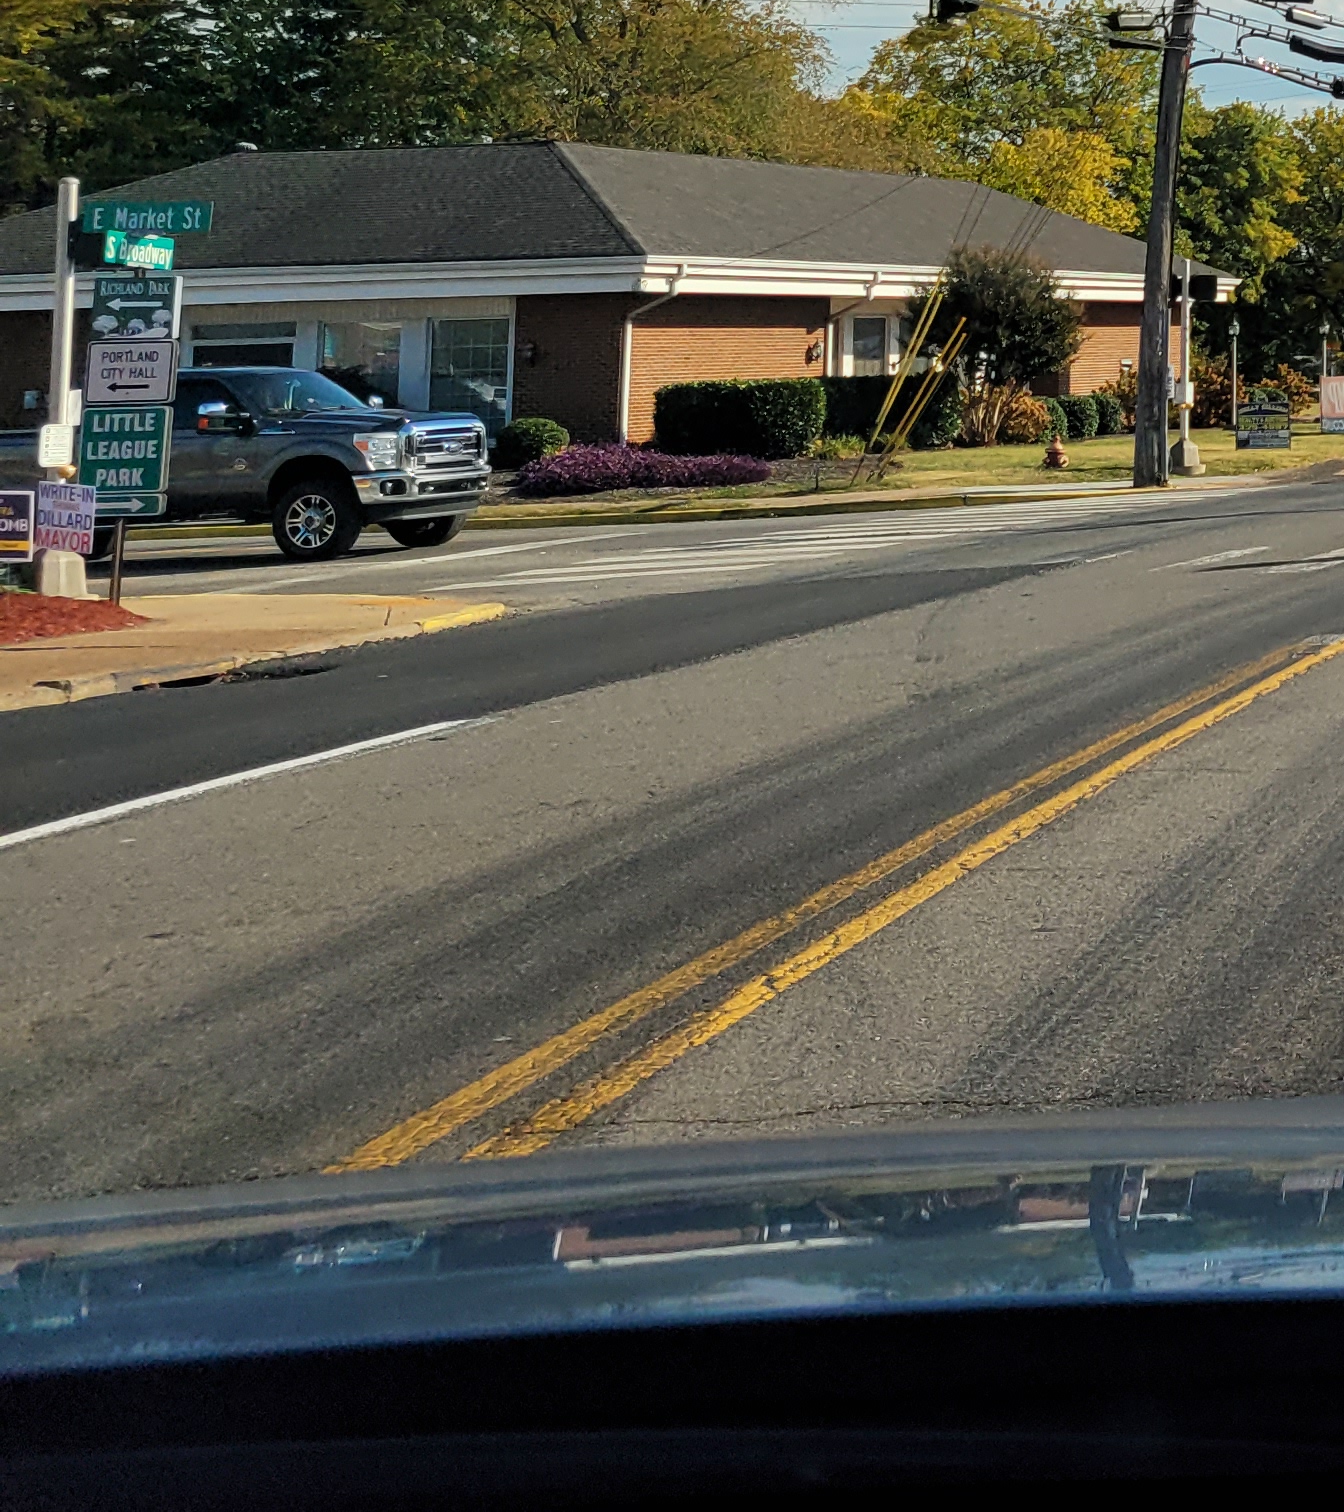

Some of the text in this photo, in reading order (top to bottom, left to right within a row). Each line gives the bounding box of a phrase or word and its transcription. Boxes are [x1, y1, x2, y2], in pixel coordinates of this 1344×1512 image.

[93, 206, 202, 230] E Market St
[106, 235, 174, 270] S Broadway
[148, 280, 171, 295] PARK
[101, 350, 160, 364] PORTLAND
[101, 367, 158, 380] CITY HALL
[91, 412, 157, 433] LITTLE
[86, 439, 158, 461] LEAGUE
[95, 467, 145, 488] PARK
[40, 484, 94, 503] WRITE-IN
[38, 509, 93, 531] DILLARD
[35, 528, 92, 553] MAYOR
